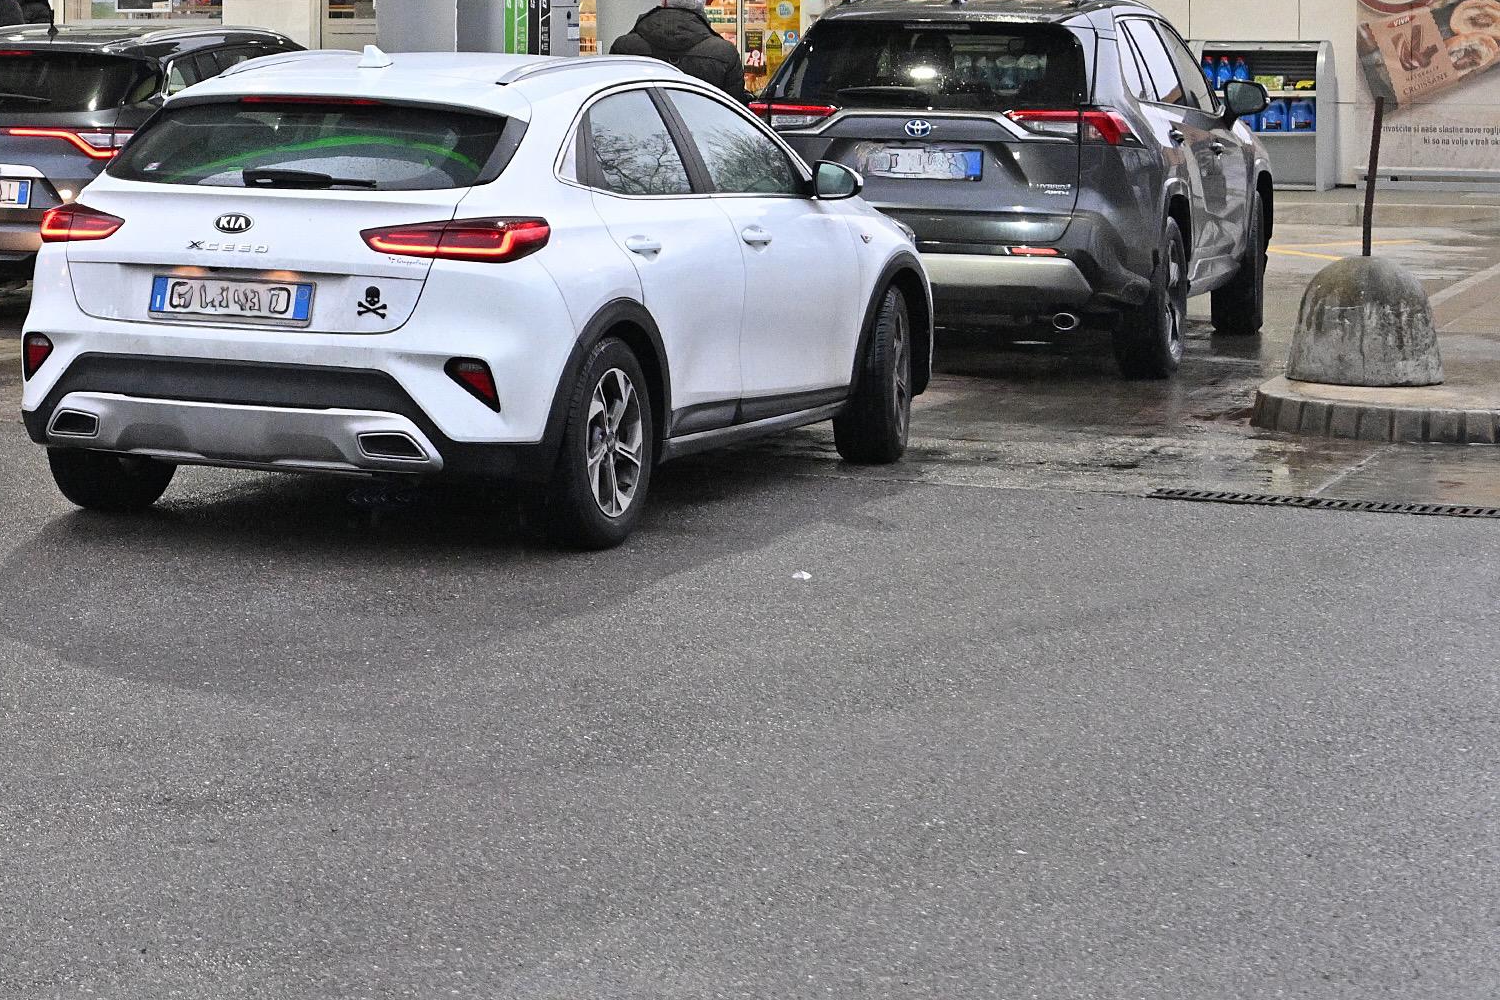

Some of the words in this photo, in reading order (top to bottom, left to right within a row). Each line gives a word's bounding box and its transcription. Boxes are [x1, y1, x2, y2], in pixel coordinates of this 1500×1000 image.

[1423, 136, 1430, 145] ki
[1441, 137, 1450, 145] na
[218, 216, 247, 230] KIA
[183, 240, 269, 255] XCEED
